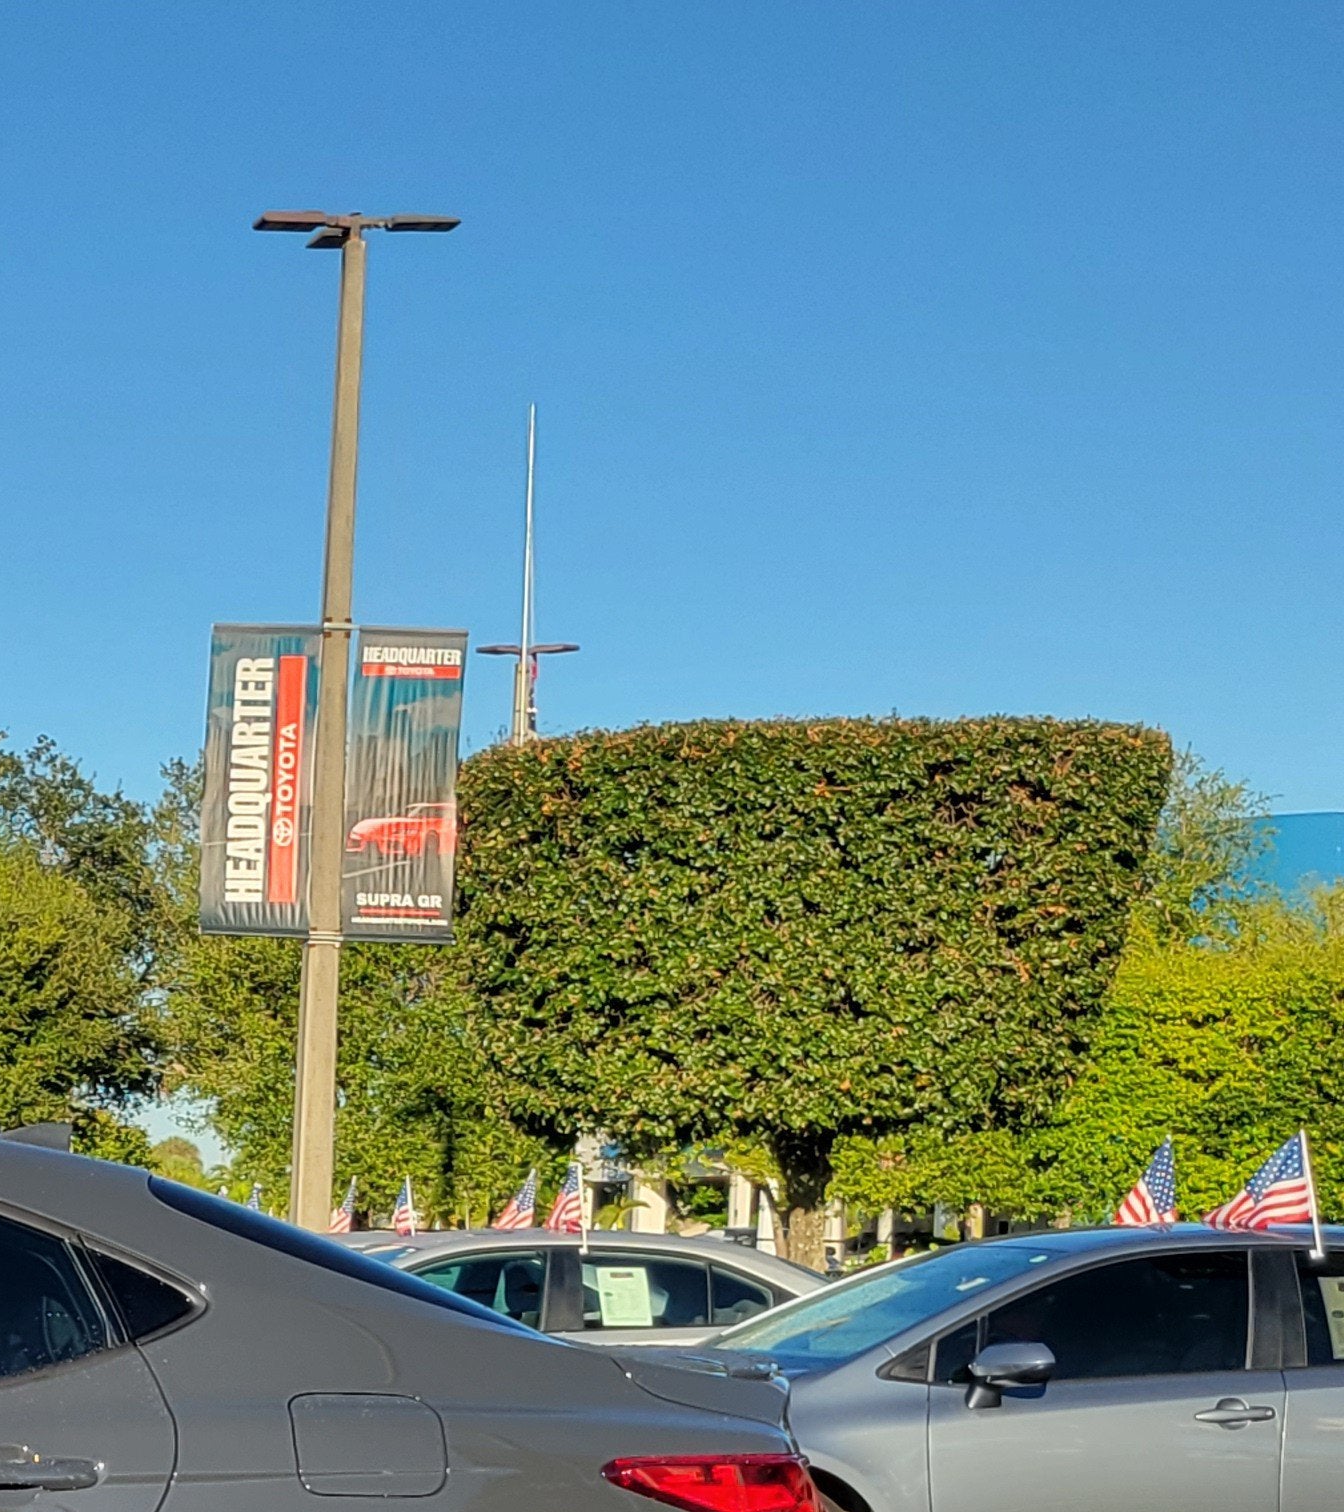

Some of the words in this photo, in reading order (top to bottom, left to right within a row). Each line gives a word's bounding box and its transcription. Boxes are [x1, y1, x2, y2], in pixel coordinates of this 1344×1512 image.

[363, 646, 461, 665] HEADQUARTER
[224, 658, 273, 902] HEADQUARTER
[275, 723, 297, 816] TOYOTA
[356, 892, 414, 907] SUPRA
[418, 895, 442, 908] GR
